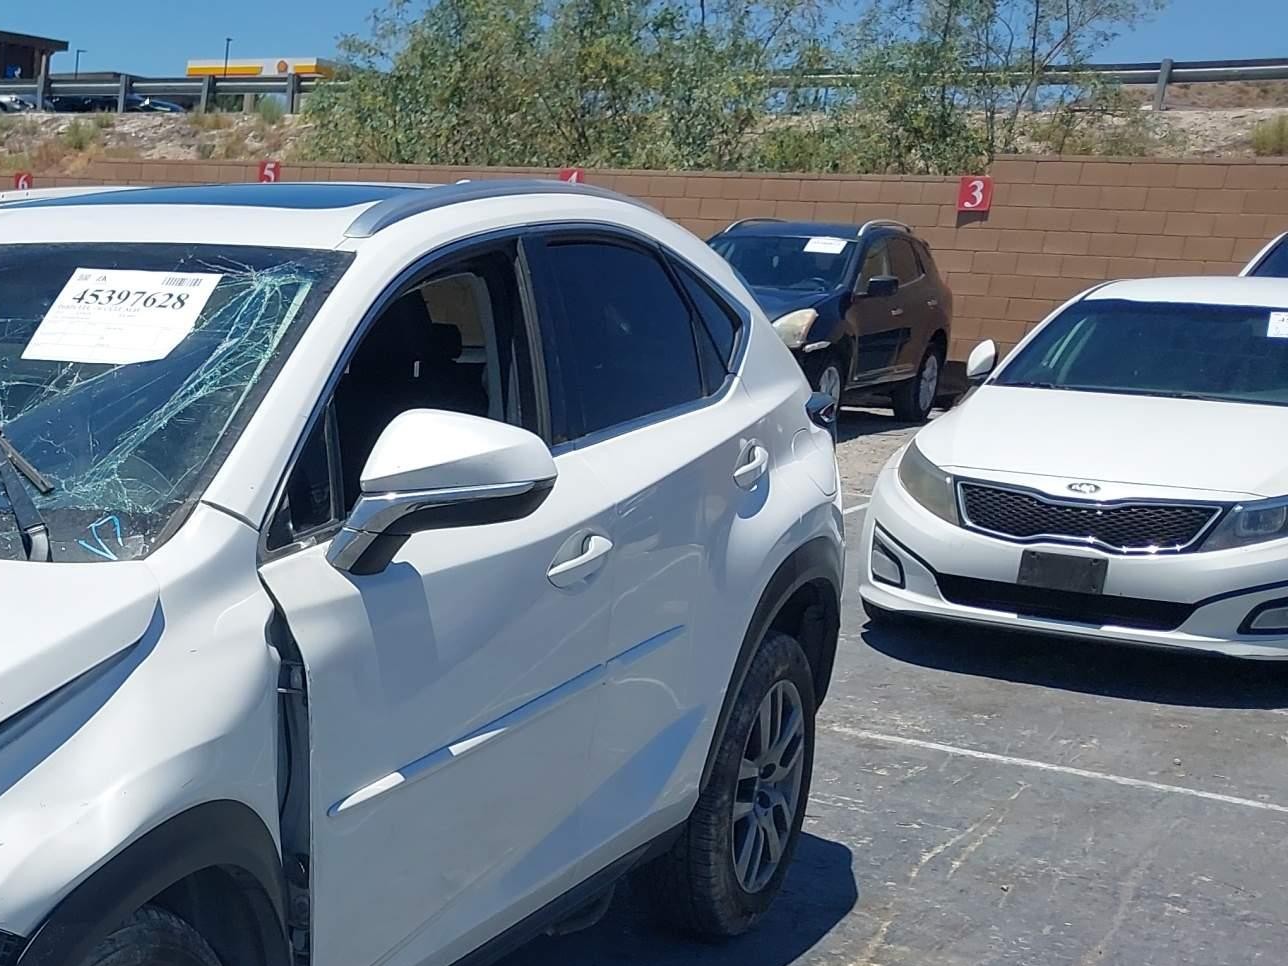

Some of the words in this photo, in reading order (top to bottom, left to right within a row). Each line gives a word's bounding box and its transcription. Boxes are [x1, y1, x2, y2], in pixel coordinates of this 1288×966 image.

[18, 174, 28, 190] 6
[263, 163, 275, 183] 5
[963, 180, 985, 208] 3
[72, 288, 190, 310] 45397628
